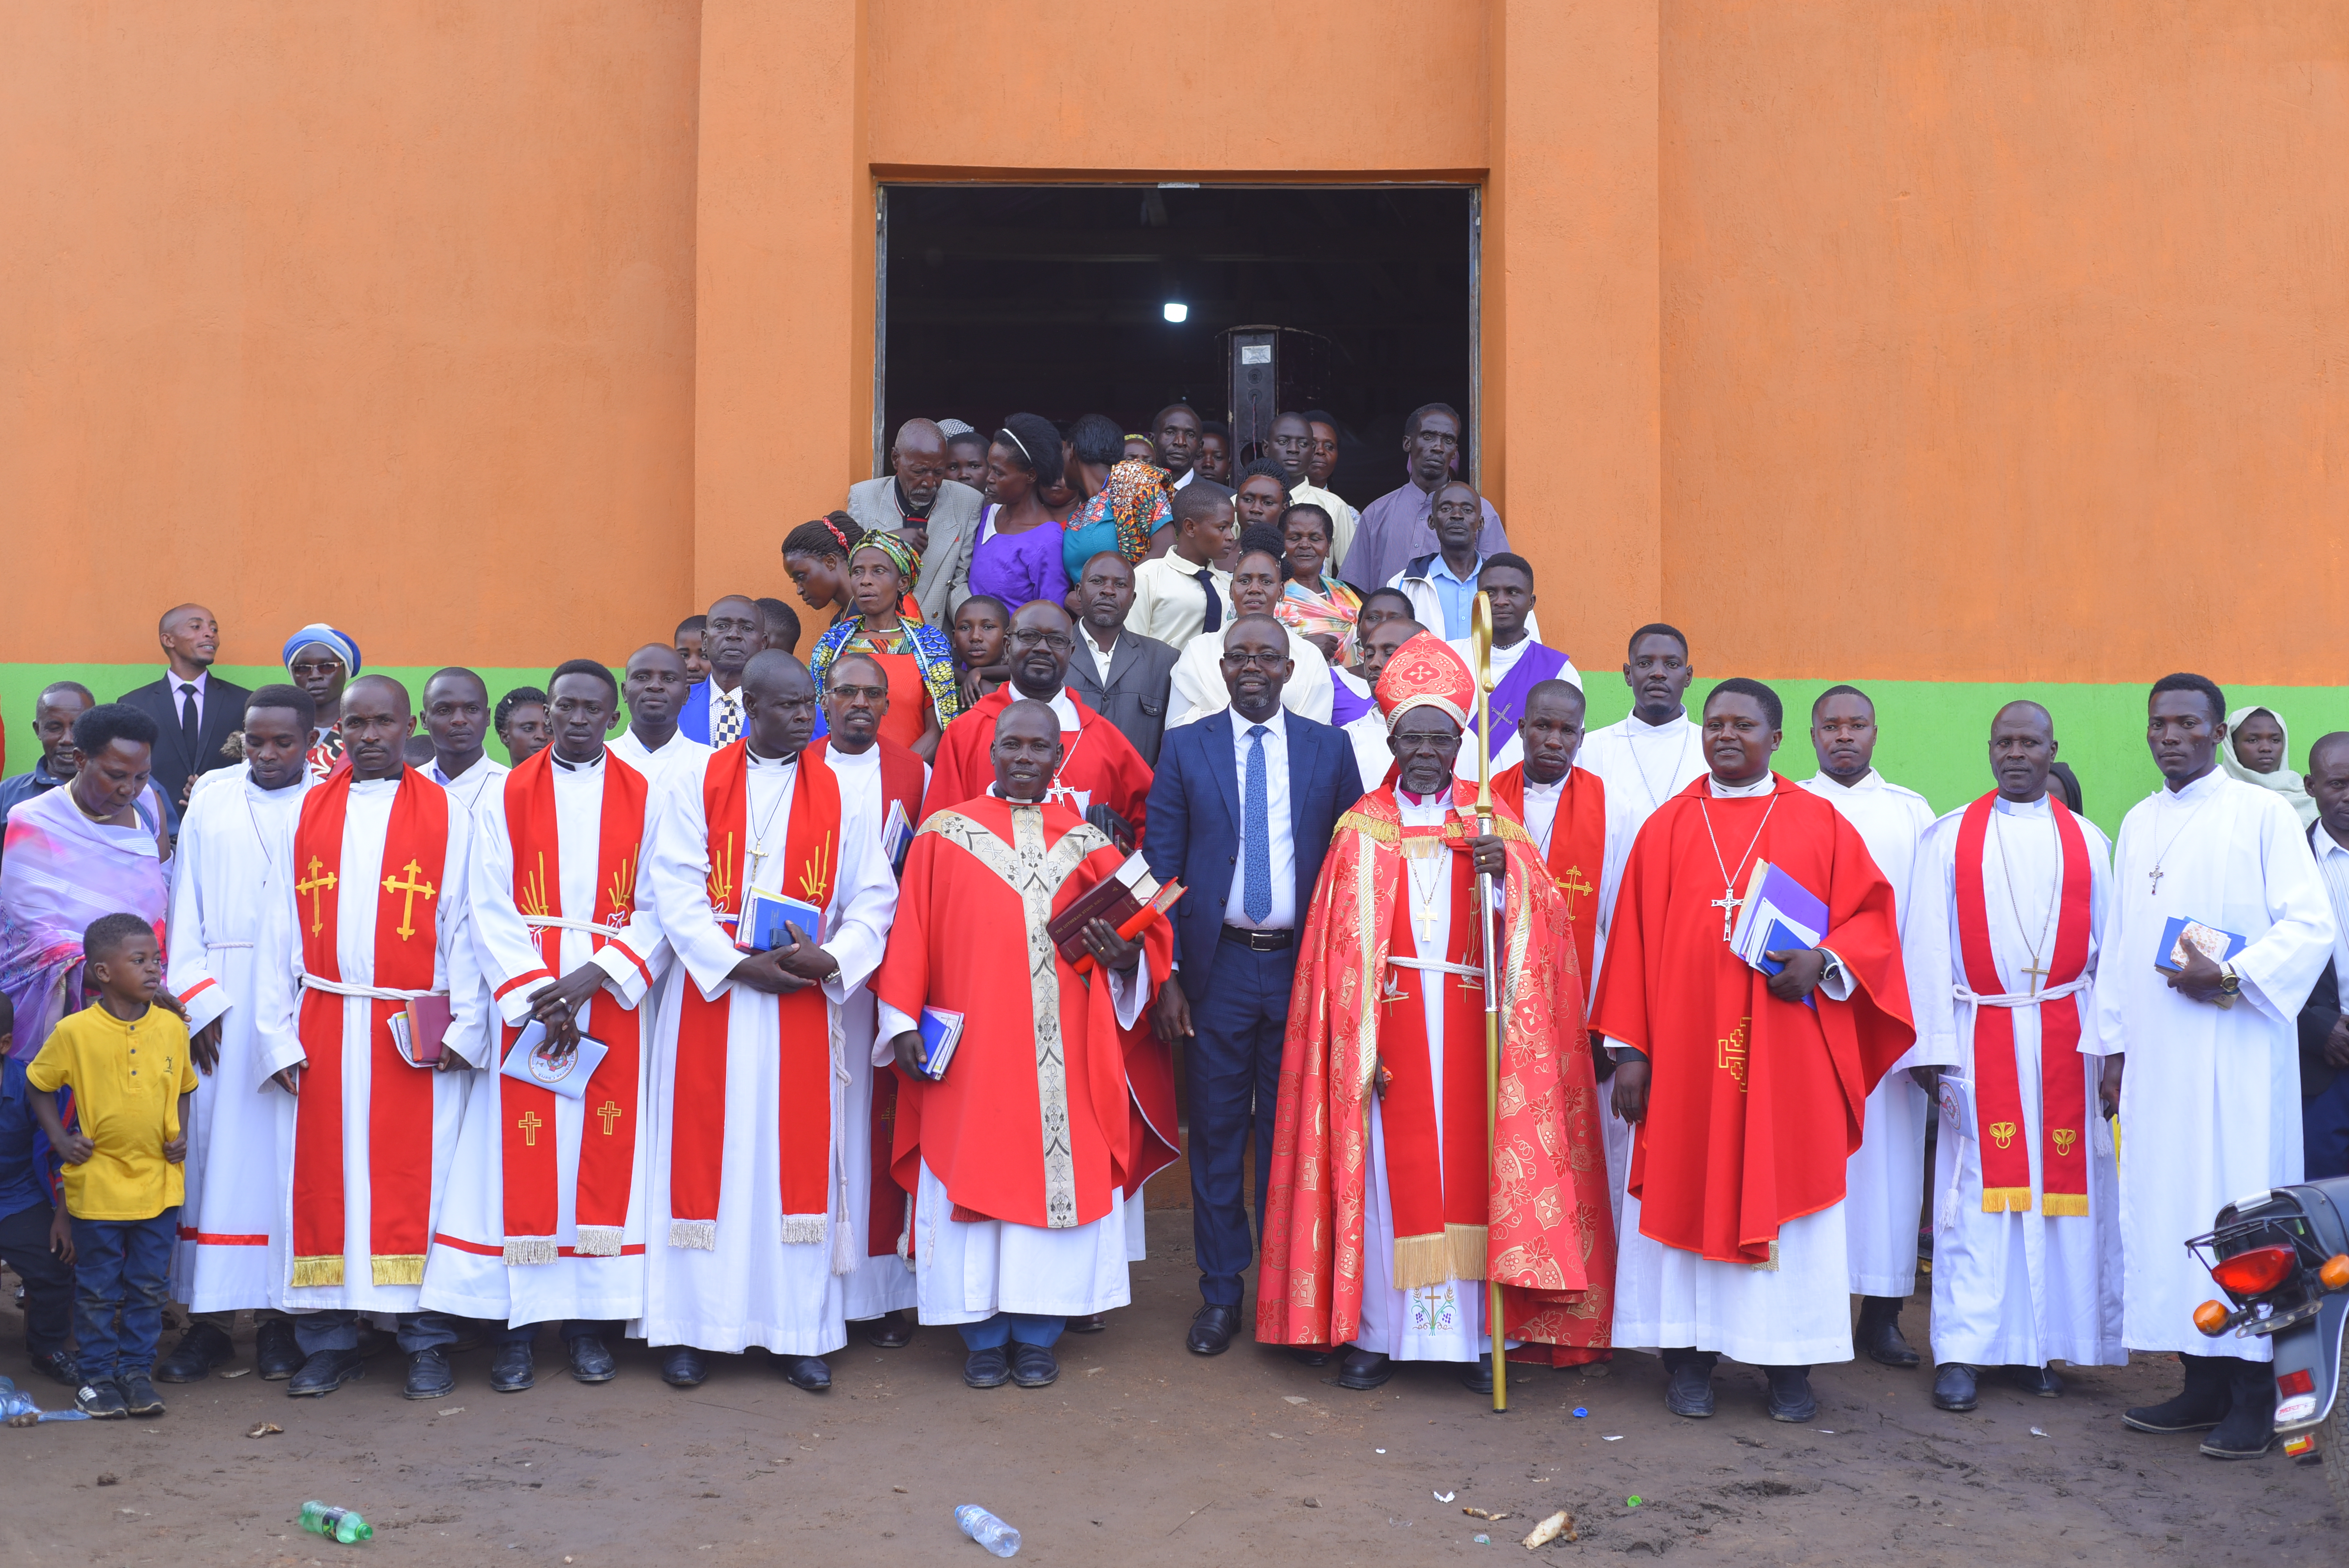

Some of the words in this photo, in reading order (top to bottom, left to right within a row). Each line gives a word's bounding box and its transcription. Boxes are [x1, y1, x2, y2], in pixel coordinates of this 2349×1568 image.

[1063, 913, 1082, 928] LUTHERAN
[1082, 904, 1094, 914] STUDY
[1094, 897, 1104, 905] BIBLE
[557, 1061, 574, 1077] Lutheran
[2278, 1404, 2304, 1415] MRF
